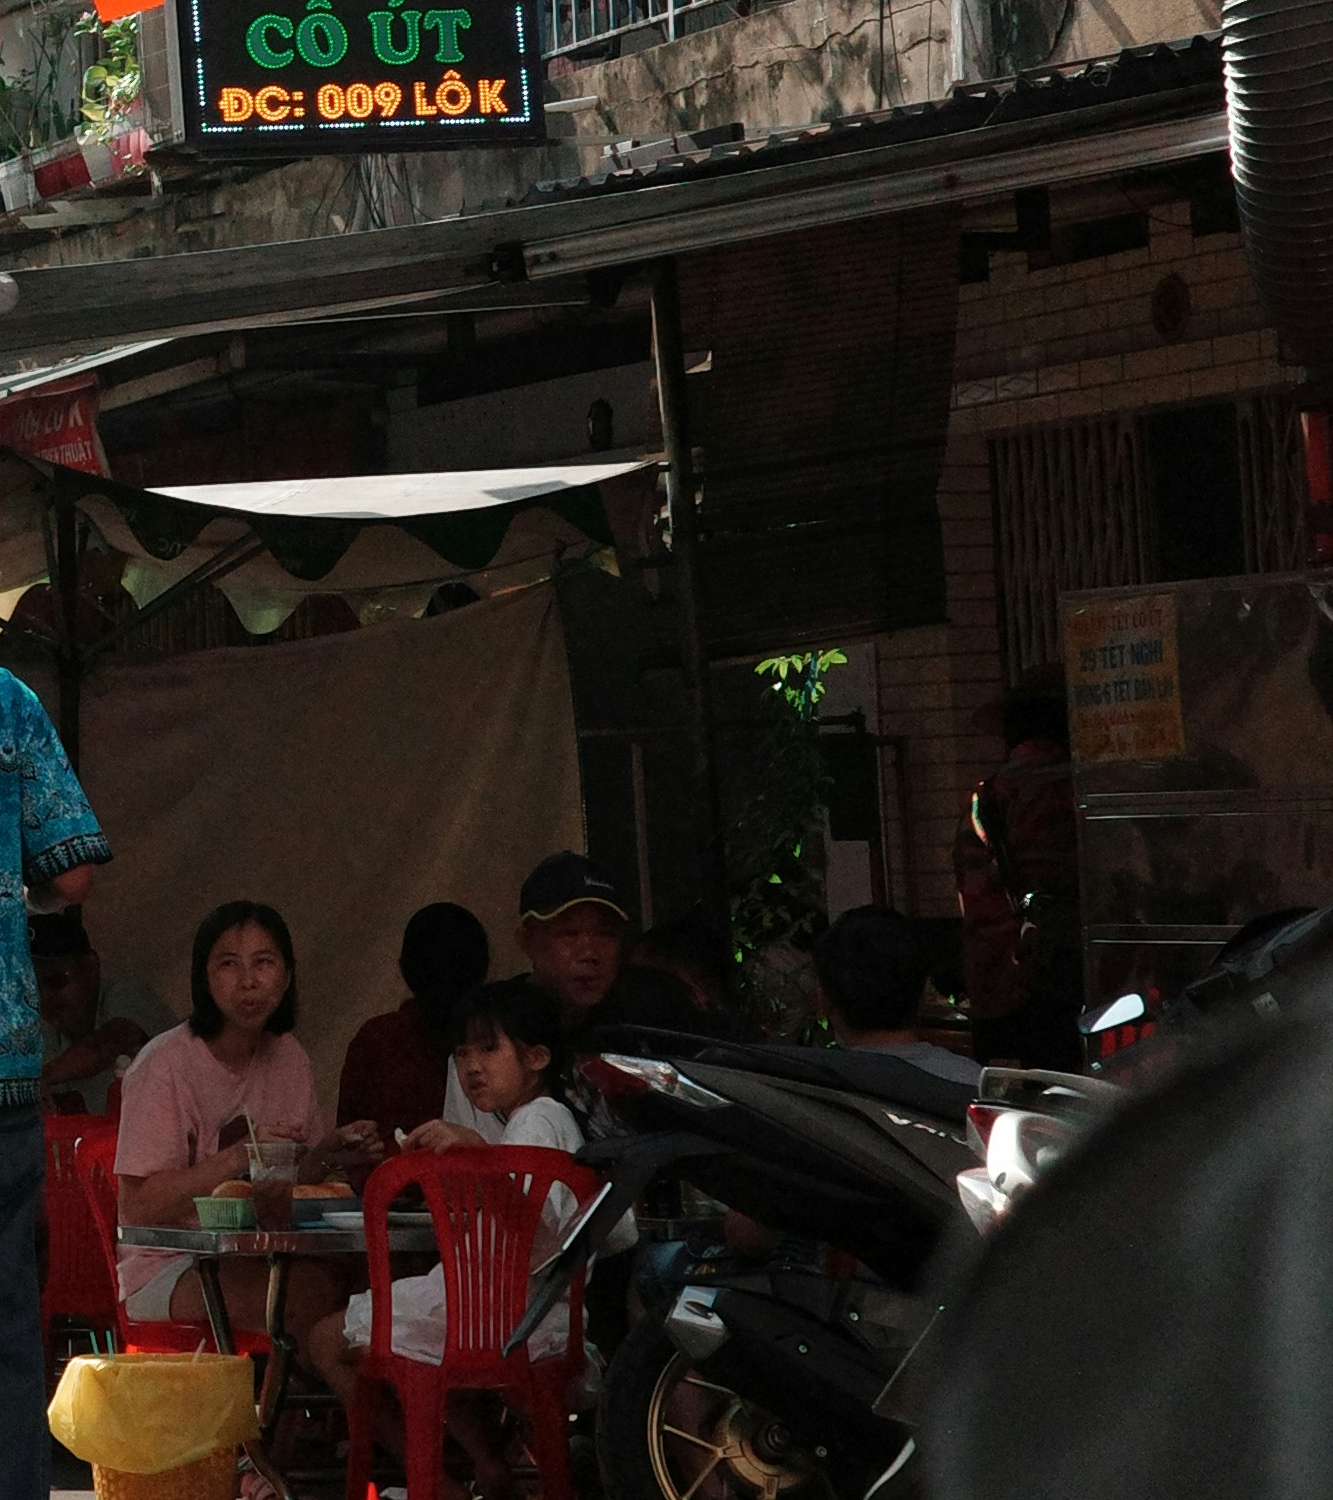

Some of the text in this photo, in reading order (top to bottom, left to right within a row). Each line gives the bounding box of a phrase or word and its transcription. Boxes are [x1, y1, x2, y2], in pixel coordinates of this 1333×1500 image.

[218, 69, 509, 122] ĐC: 009 LÔ K
